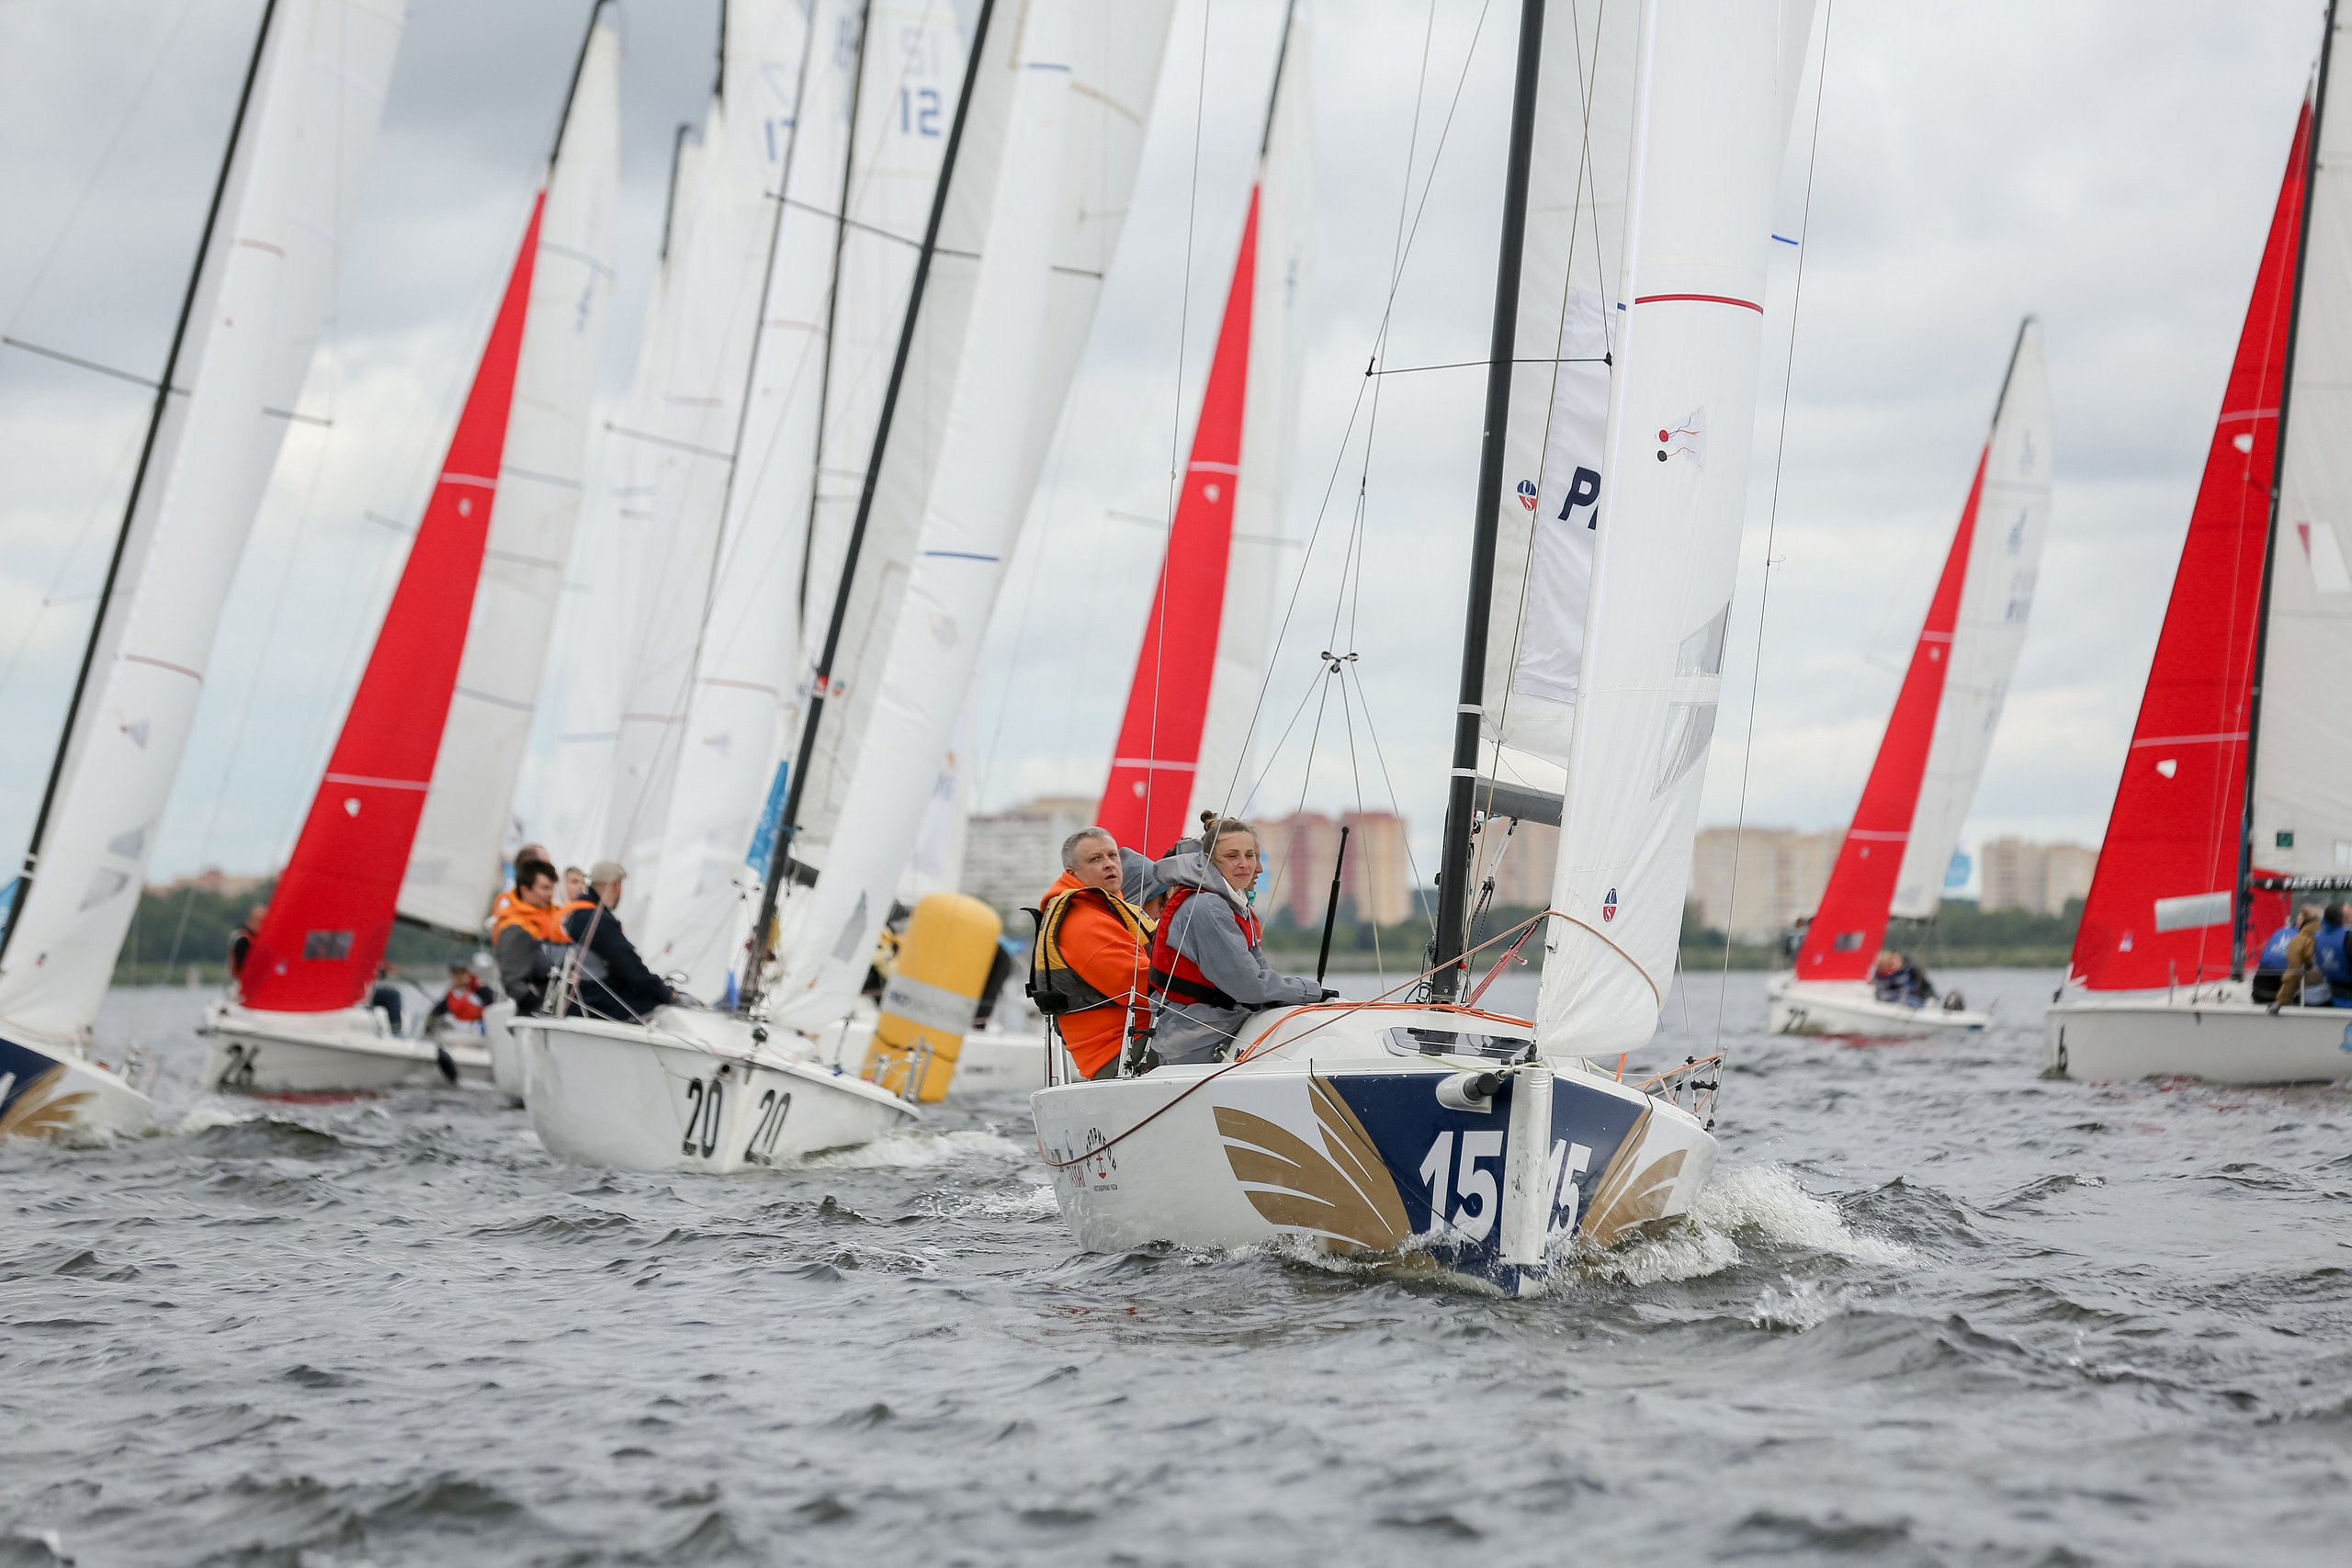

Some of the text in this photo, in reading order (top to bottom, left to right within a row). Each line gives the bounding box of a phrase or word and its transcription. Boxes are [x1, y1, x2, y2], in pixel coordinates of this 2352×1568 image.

[900, 86, 941, 137] 12
[1557, 466, 1600, 531] P
[683, 1077, 722, 1158] 20
[744, 1089, 791, 1166] 20
[1419, 1131, 1504, 1243] 15
[1546, 1138, 1592, 1238] 15
